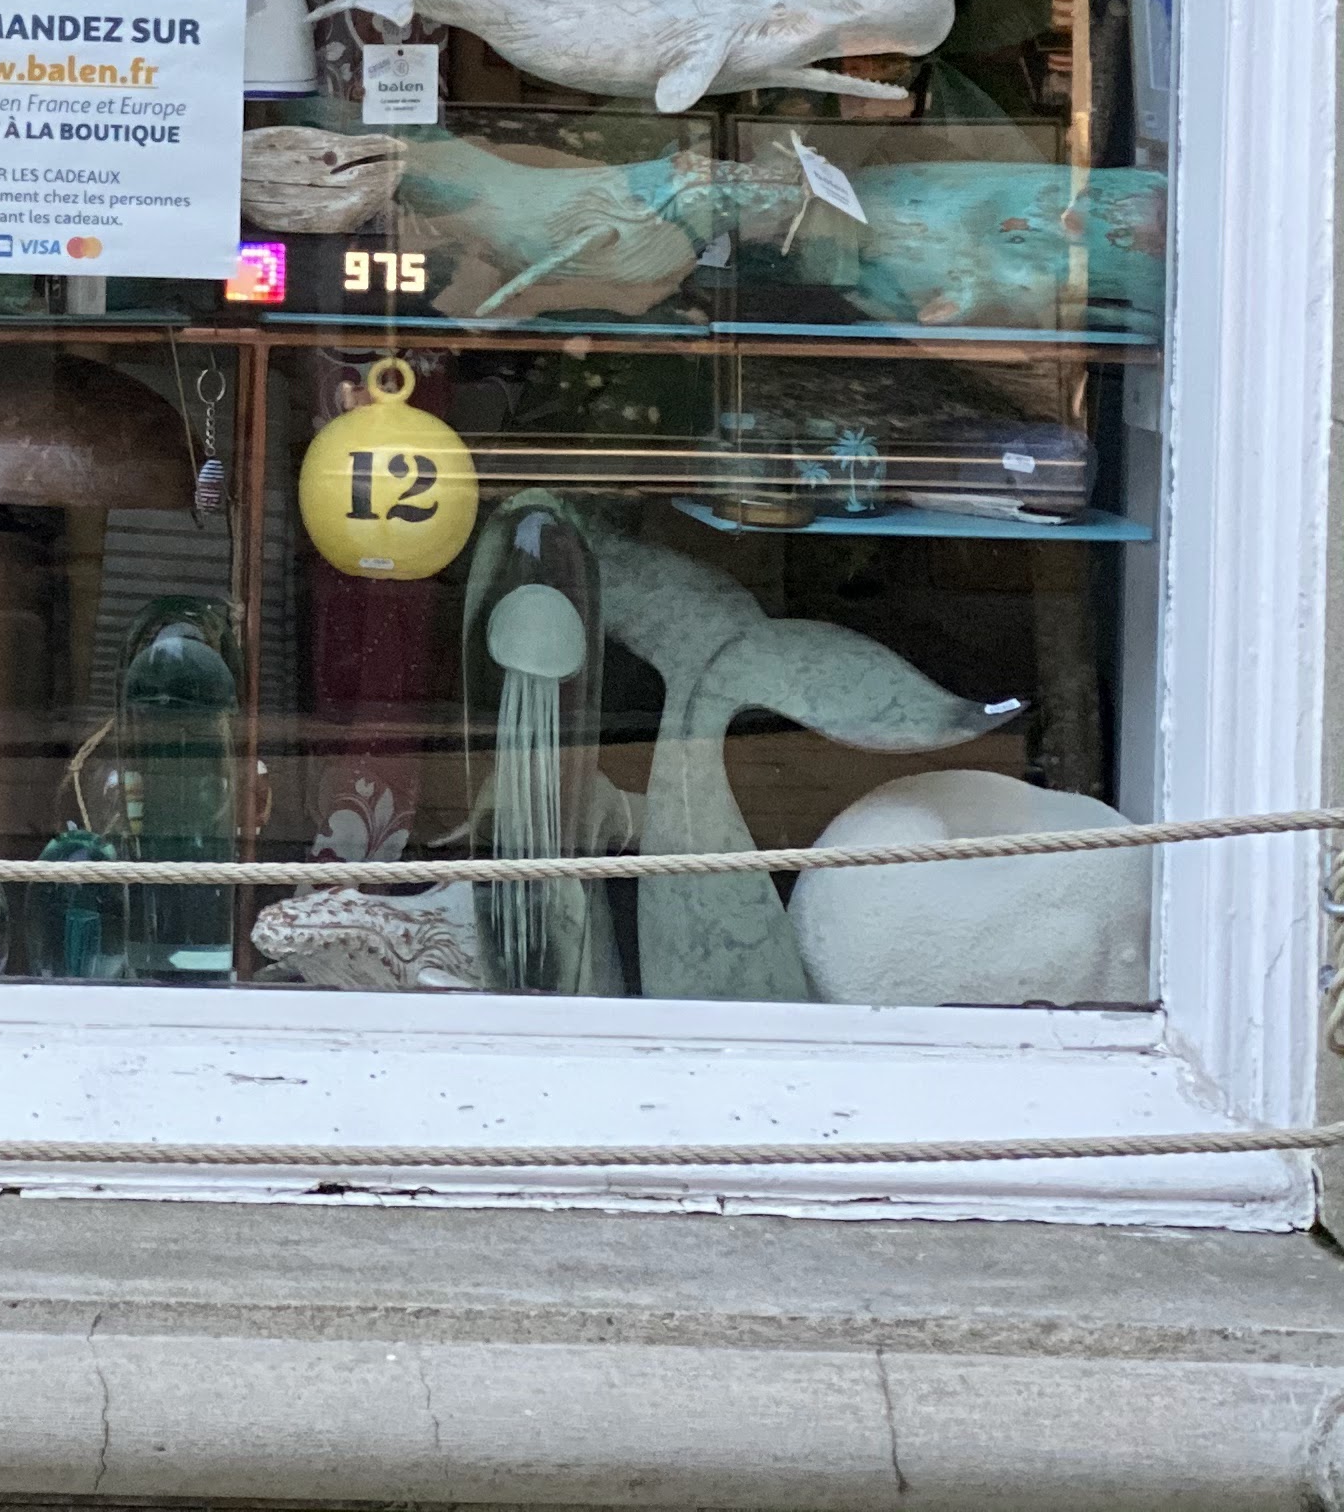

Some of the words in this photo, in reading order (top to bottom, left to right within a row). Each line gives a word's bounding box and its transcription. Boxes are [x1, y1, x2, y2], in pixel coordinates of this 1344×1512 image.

[131, 17, 201, 45] SUR
[377, 81, 424, 93] balen
[0, 98, 21, 112] en
[26, 94, 92, 115] France
[97, 99, 115, 115] et
[121, 97, 187, 123] Europe
[4, 115, 20, 139] À
[26, 122, 53, 139] LA
[60, 124, 181, 147] BOUTIQUE
[12, 167, 39, 183] LES
[44, 169, 121, 185] CADEAUX
[43, 190, 79, 205] chez
[83, 191, 105, 206] les
[109, 195, 191, 209] personnes
[28, 209, 51, 224] les
[54, 210, 123, 227] cadeaux.
[344, 251, 426, 292] 975
[345, 449, 443, 525] 12
